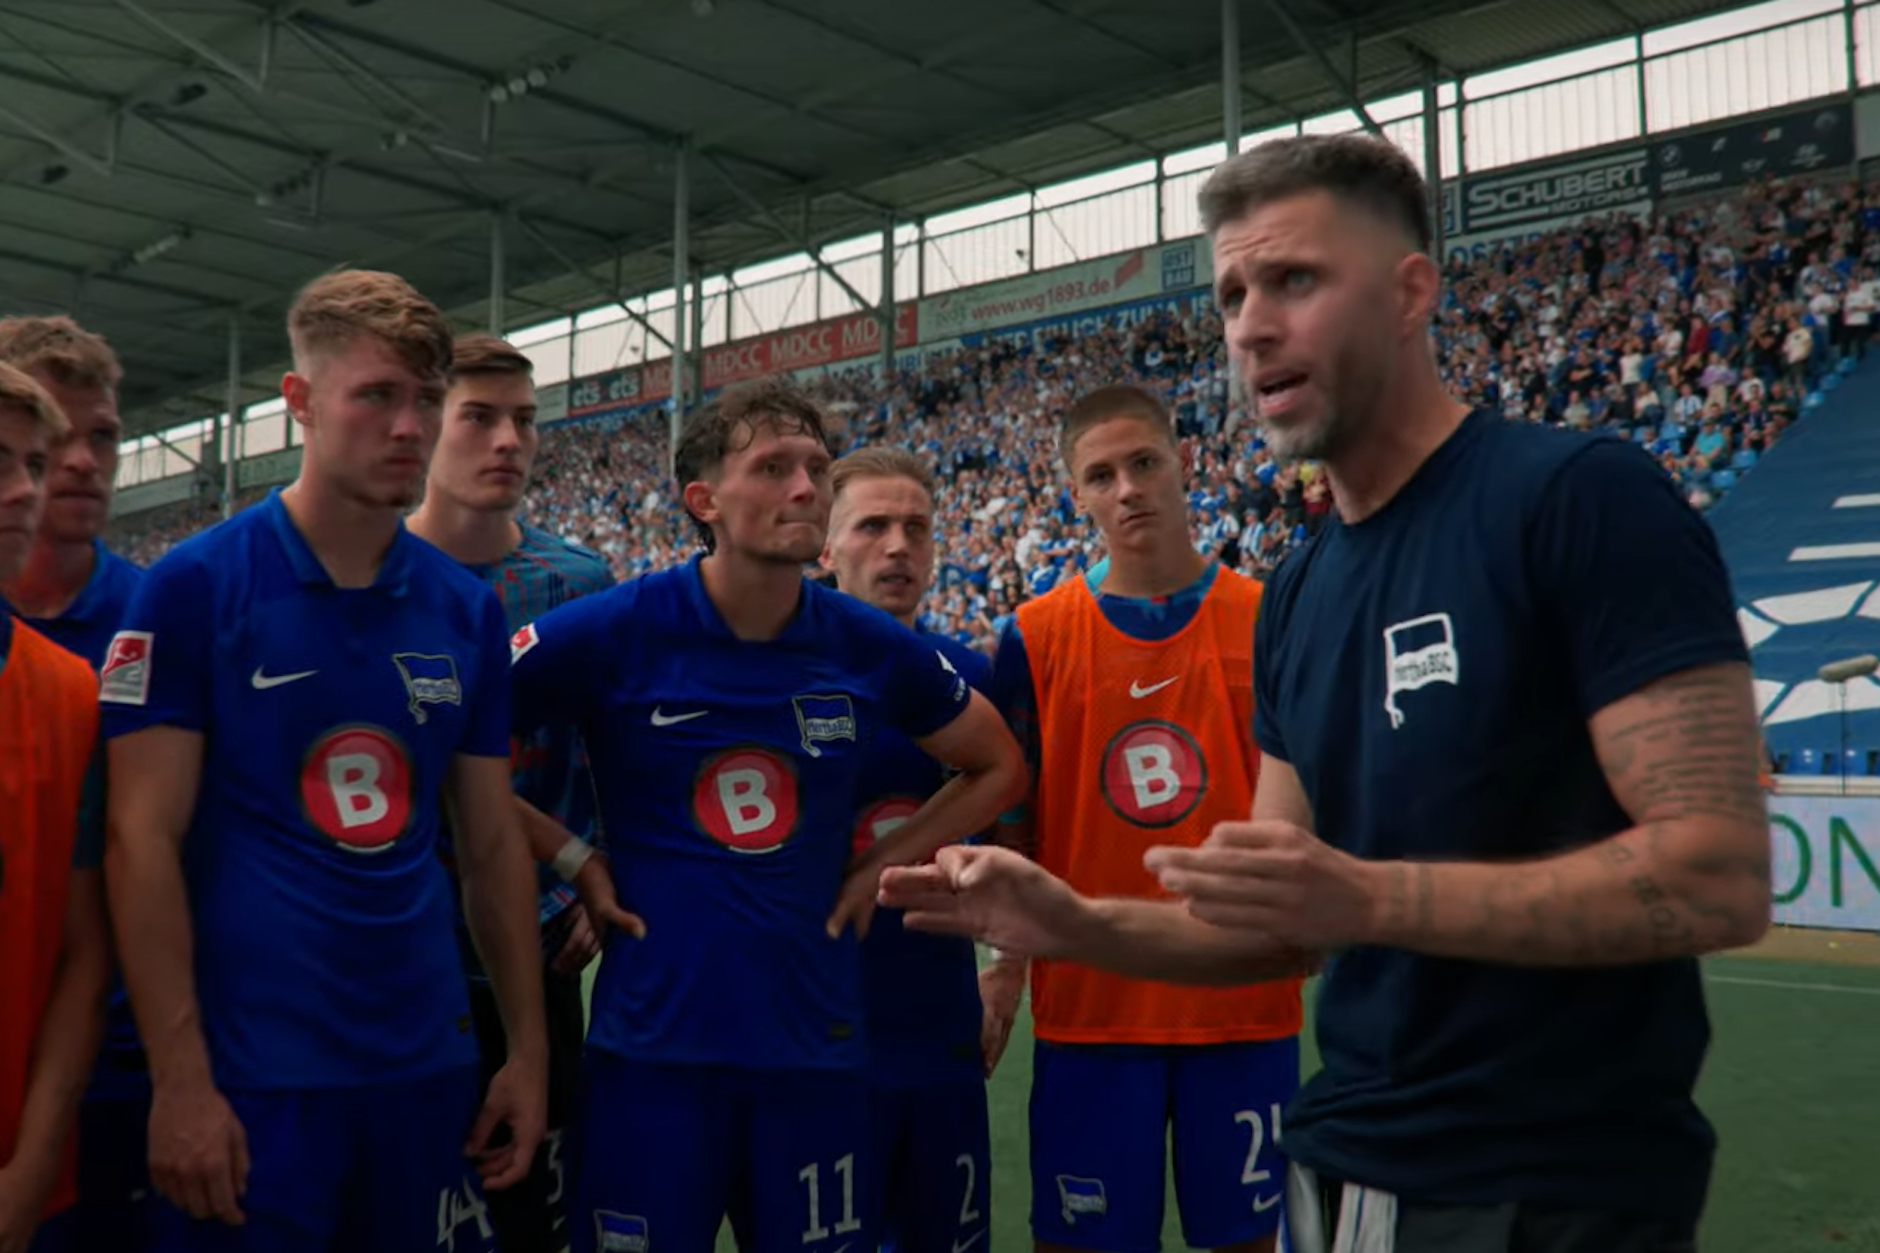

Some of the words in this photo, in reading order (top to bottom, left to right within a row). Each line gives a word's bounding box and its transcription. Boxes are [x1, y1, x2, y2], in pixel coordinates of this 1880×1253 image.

[1468, 160, 1648, 215] SCHUBERT
[1550, 188, 1638, 212] MOTORS
[972, 279, 1110, 320] www.wg1893.de
[706, 343, 762, 377] MDCC
[770, 326, 833, 362] MDCC
[842, 309, 909, 347] MDC
[327, 754, 388, 828] B
[717, 769, 776, 835] B
[1124, 744, 1181, 808] B
[799, 1152, 861, 1244] 11
[956, 1153, 980, 1225] 2
